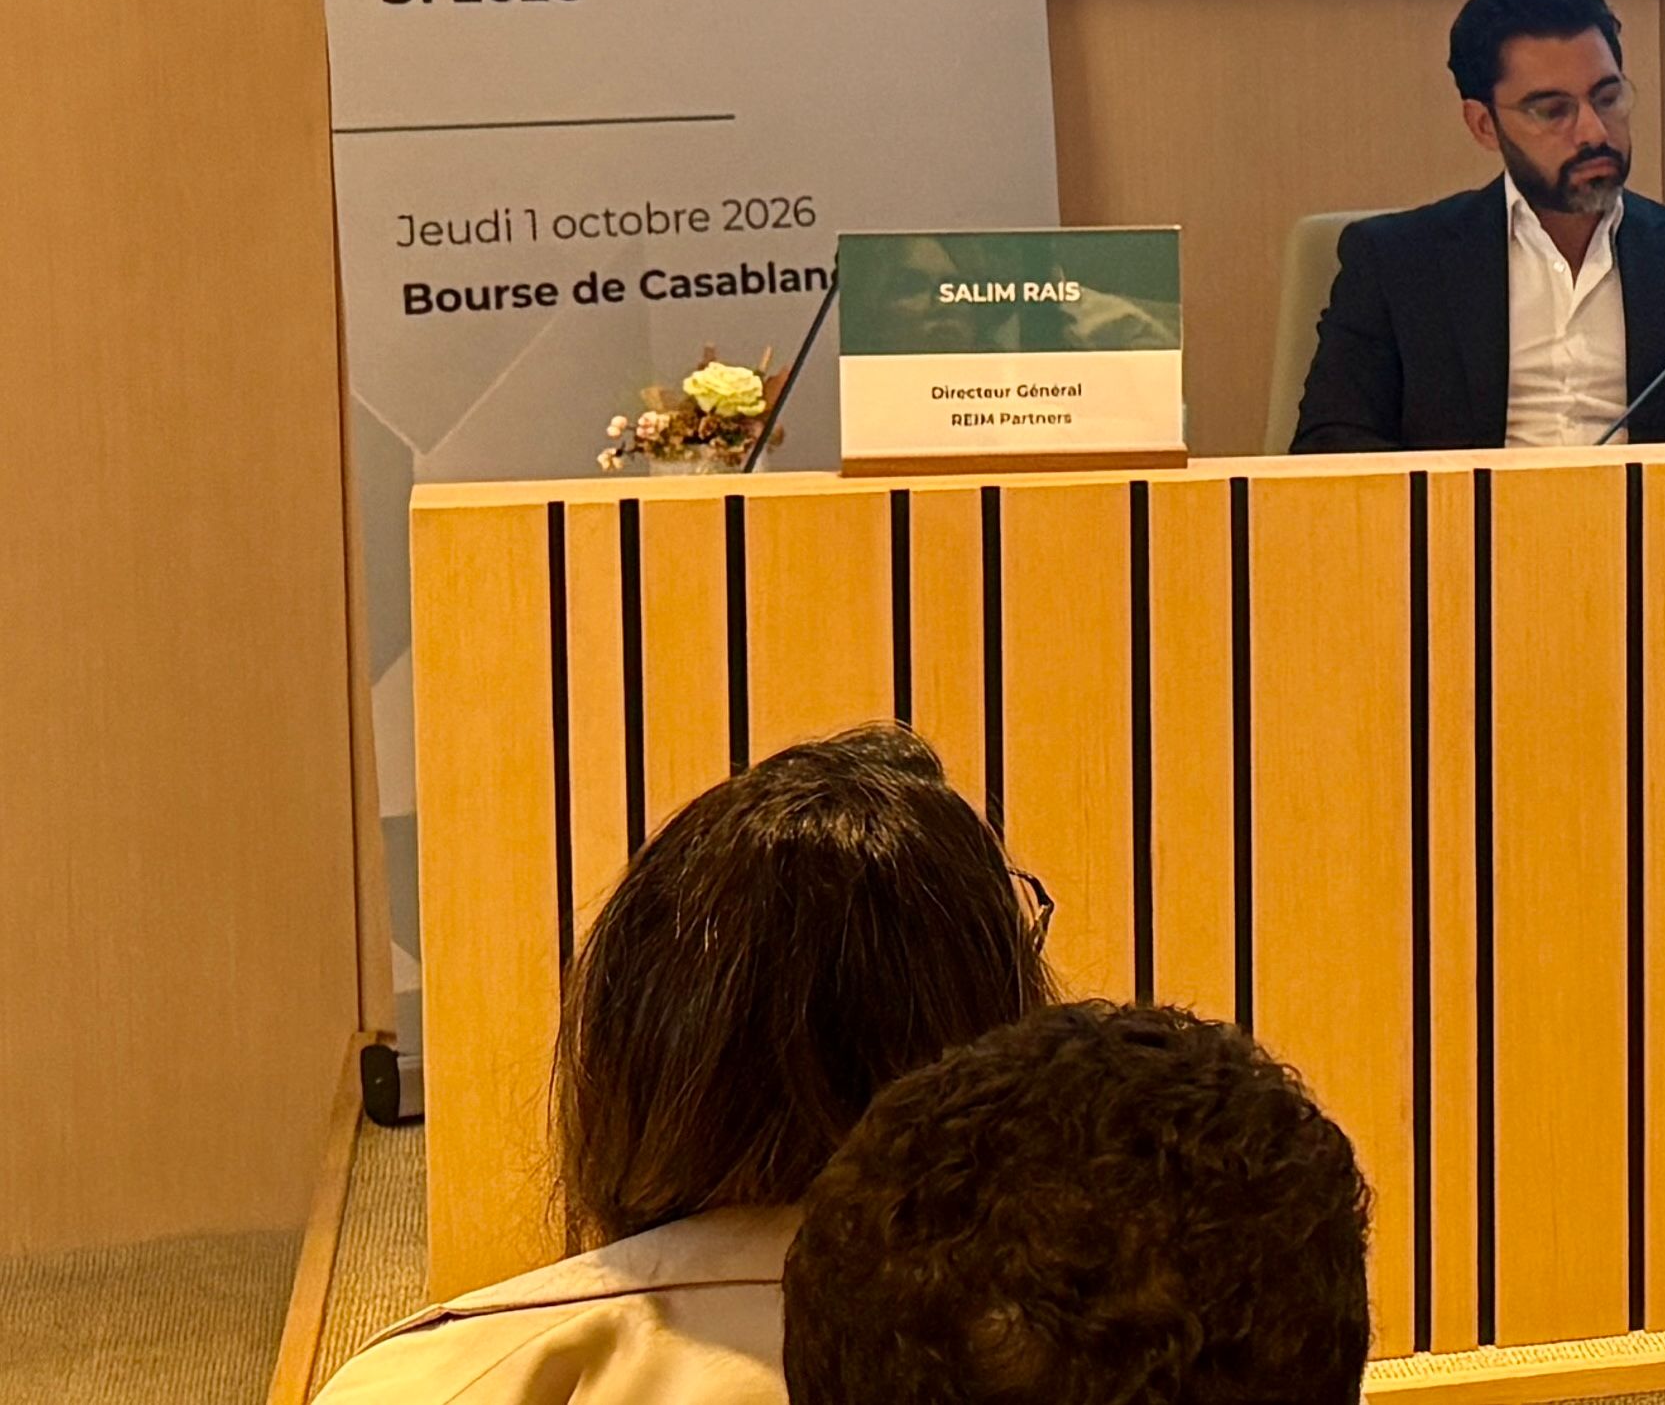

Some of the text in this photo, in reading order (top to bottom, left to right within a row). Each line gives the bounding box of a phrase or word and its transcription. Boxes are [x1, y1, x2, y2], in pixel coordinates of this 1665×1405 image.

[397, 196, 816, 247] Jeudi 1 octobre 2026
[404, 261, 839, 315] Bourse de Casablan
[939, 282, 1080, 302] SALIM RAIS
[932, 383, 1082, 399] Directeur Général
[952, 413, 1072, 426] REIM Partners
